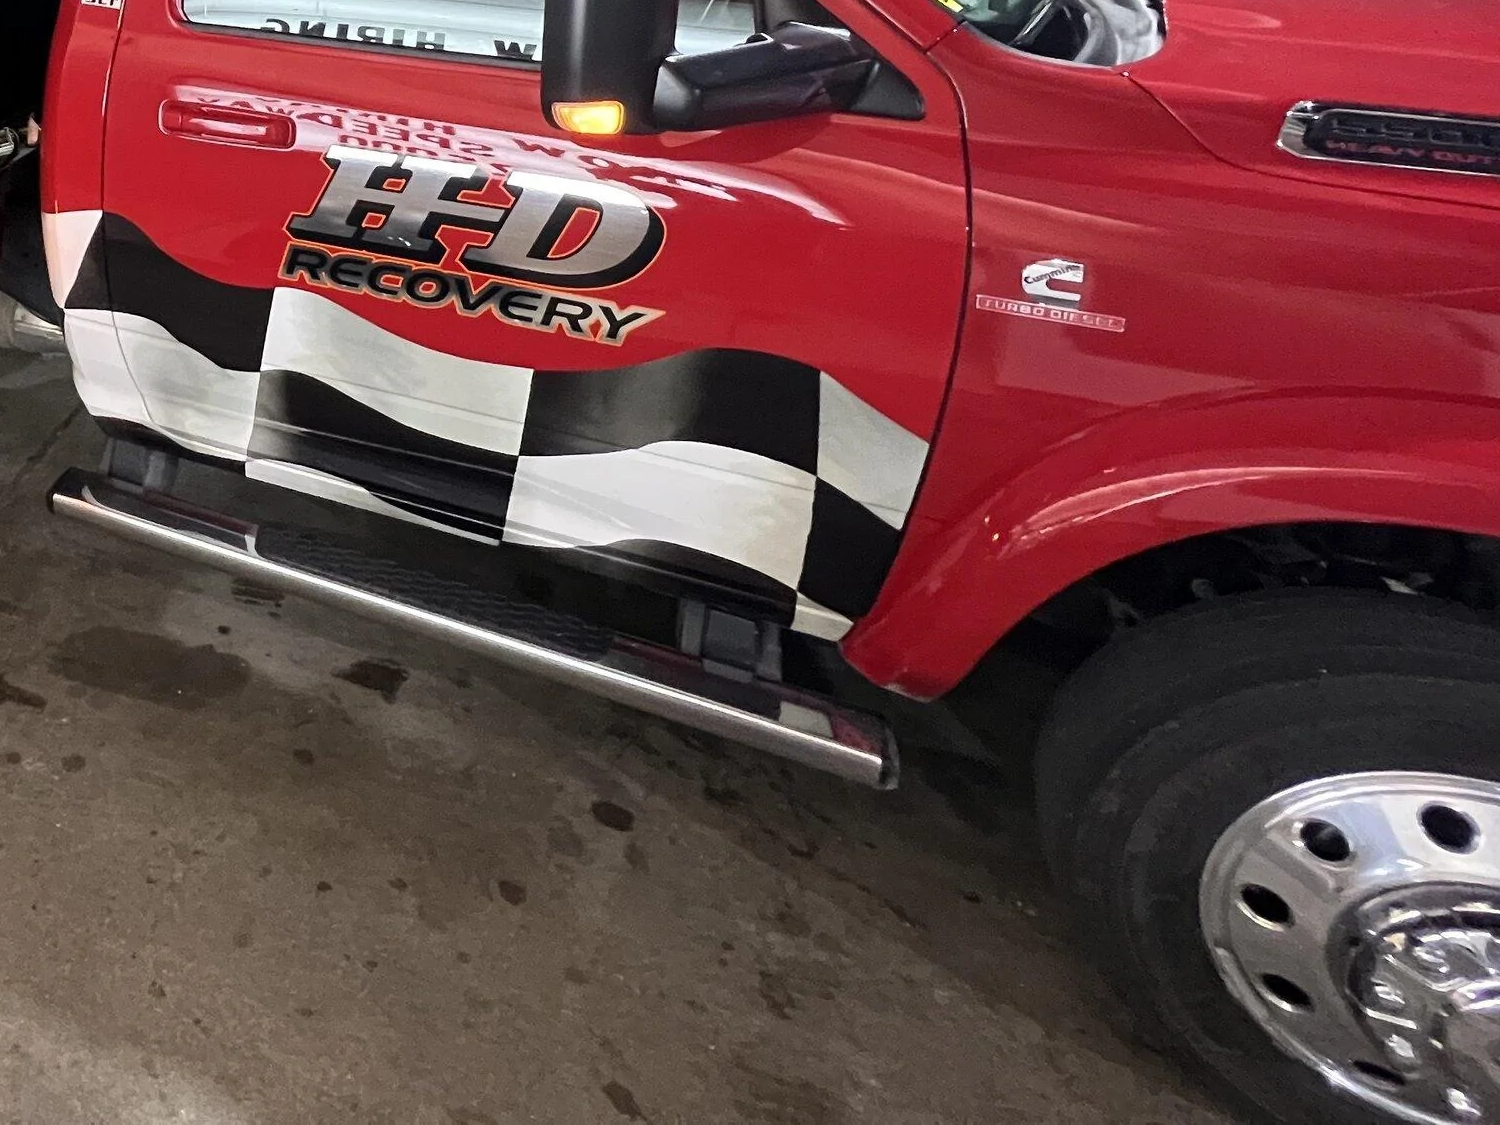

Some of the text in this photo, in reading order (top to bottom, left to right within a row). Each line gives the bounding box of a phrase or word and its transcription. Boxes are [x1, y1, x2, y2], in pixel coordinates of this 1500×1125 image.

[284, 246, 648, 341] RECOVERY
[983, 298, 1119, 328] TURBO DIESEL
